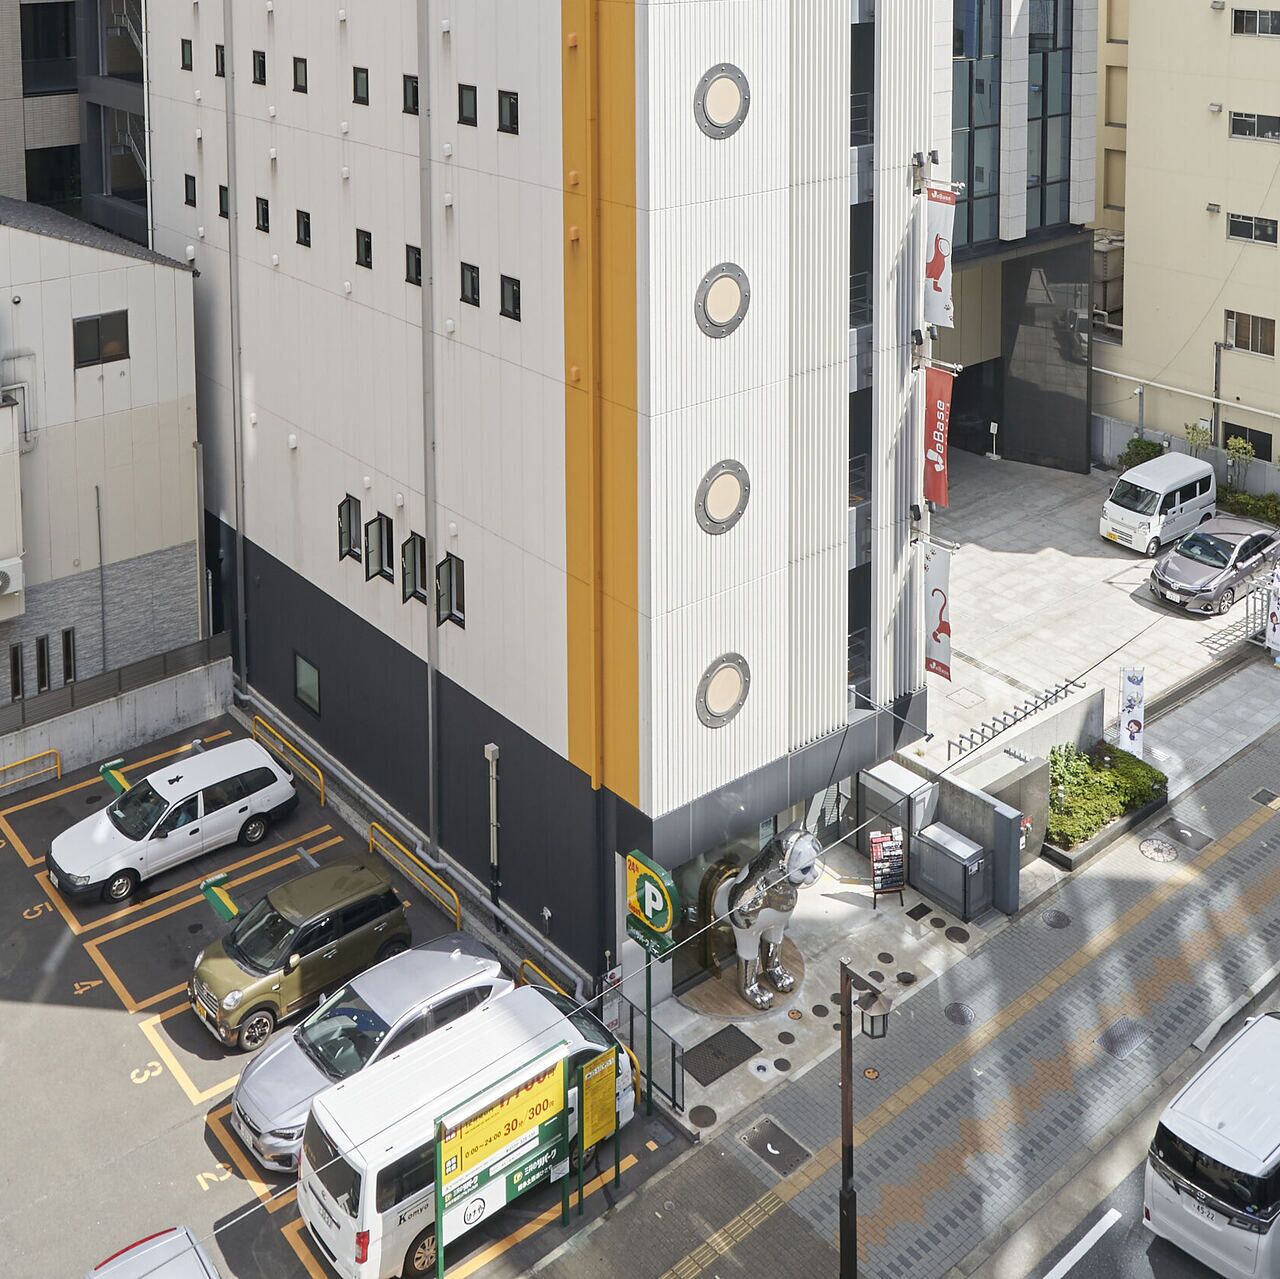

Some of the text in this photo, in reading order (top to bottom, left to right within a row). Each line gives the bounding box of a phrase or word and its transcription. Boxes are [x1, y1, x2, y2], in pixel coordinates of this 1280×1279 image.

[926, 399, 945, 472] JeBase
[22, 902, 54, 920] 5
[644, 880, 664, 919] P
[71, 979, 104, 997] 4
[130, 1061, 163, 1084] 3
[196, 1162, 233, 1192] 2
